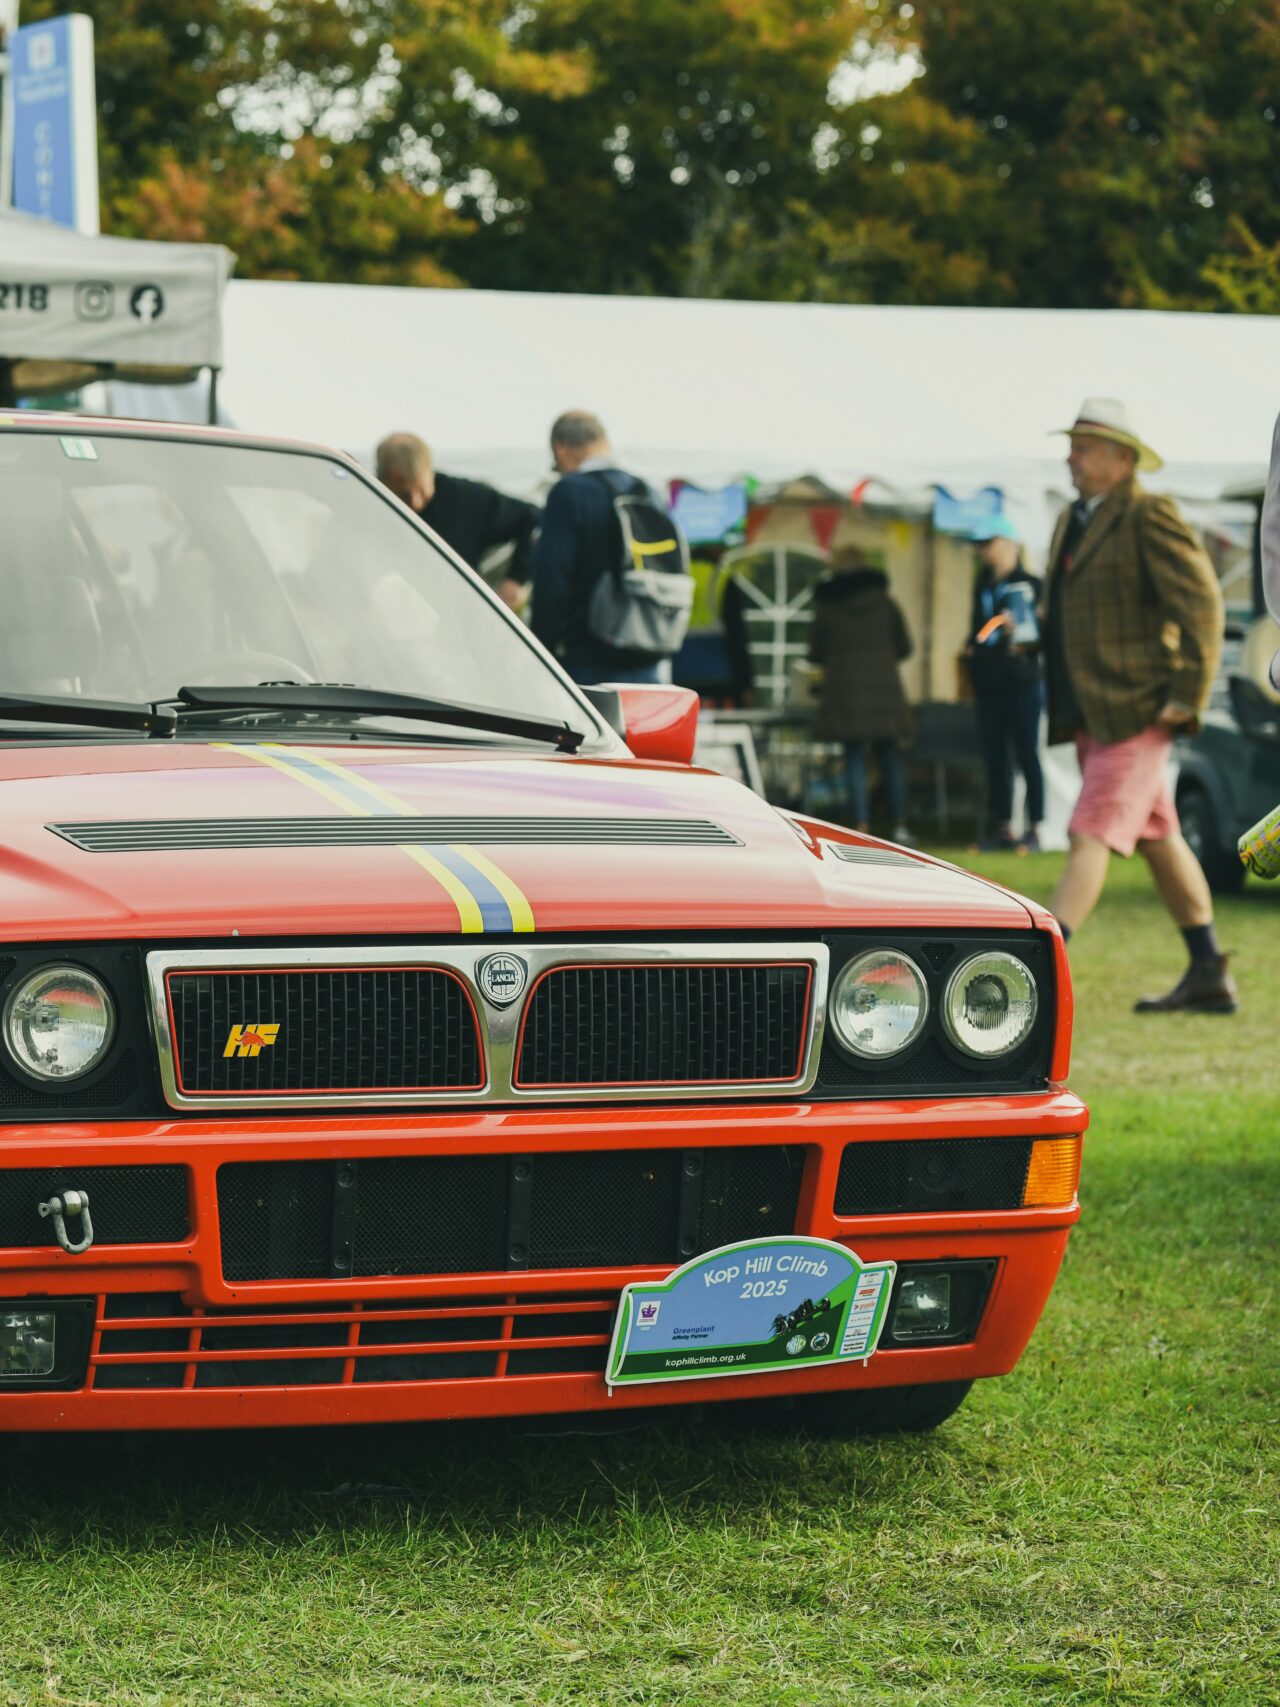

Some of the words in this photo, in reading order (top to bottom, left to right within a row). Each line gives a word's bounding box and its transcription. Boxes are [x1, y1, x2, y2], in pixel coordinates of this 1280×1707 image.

[491, 973, 516, 983] LANCIA
[222, 1023, 281, 1058] HF
[703, 1265, 740, 1288] Kop
[744, 1256, 773, 1275] Hill
[776, 1255, 829, 1278] Climb
[739, 1279, 789, 1299] 2025
[672, 1325, 715, 1335] Greenplant
[665, 1352, 747, 1367] kophillclimb.org.uk
